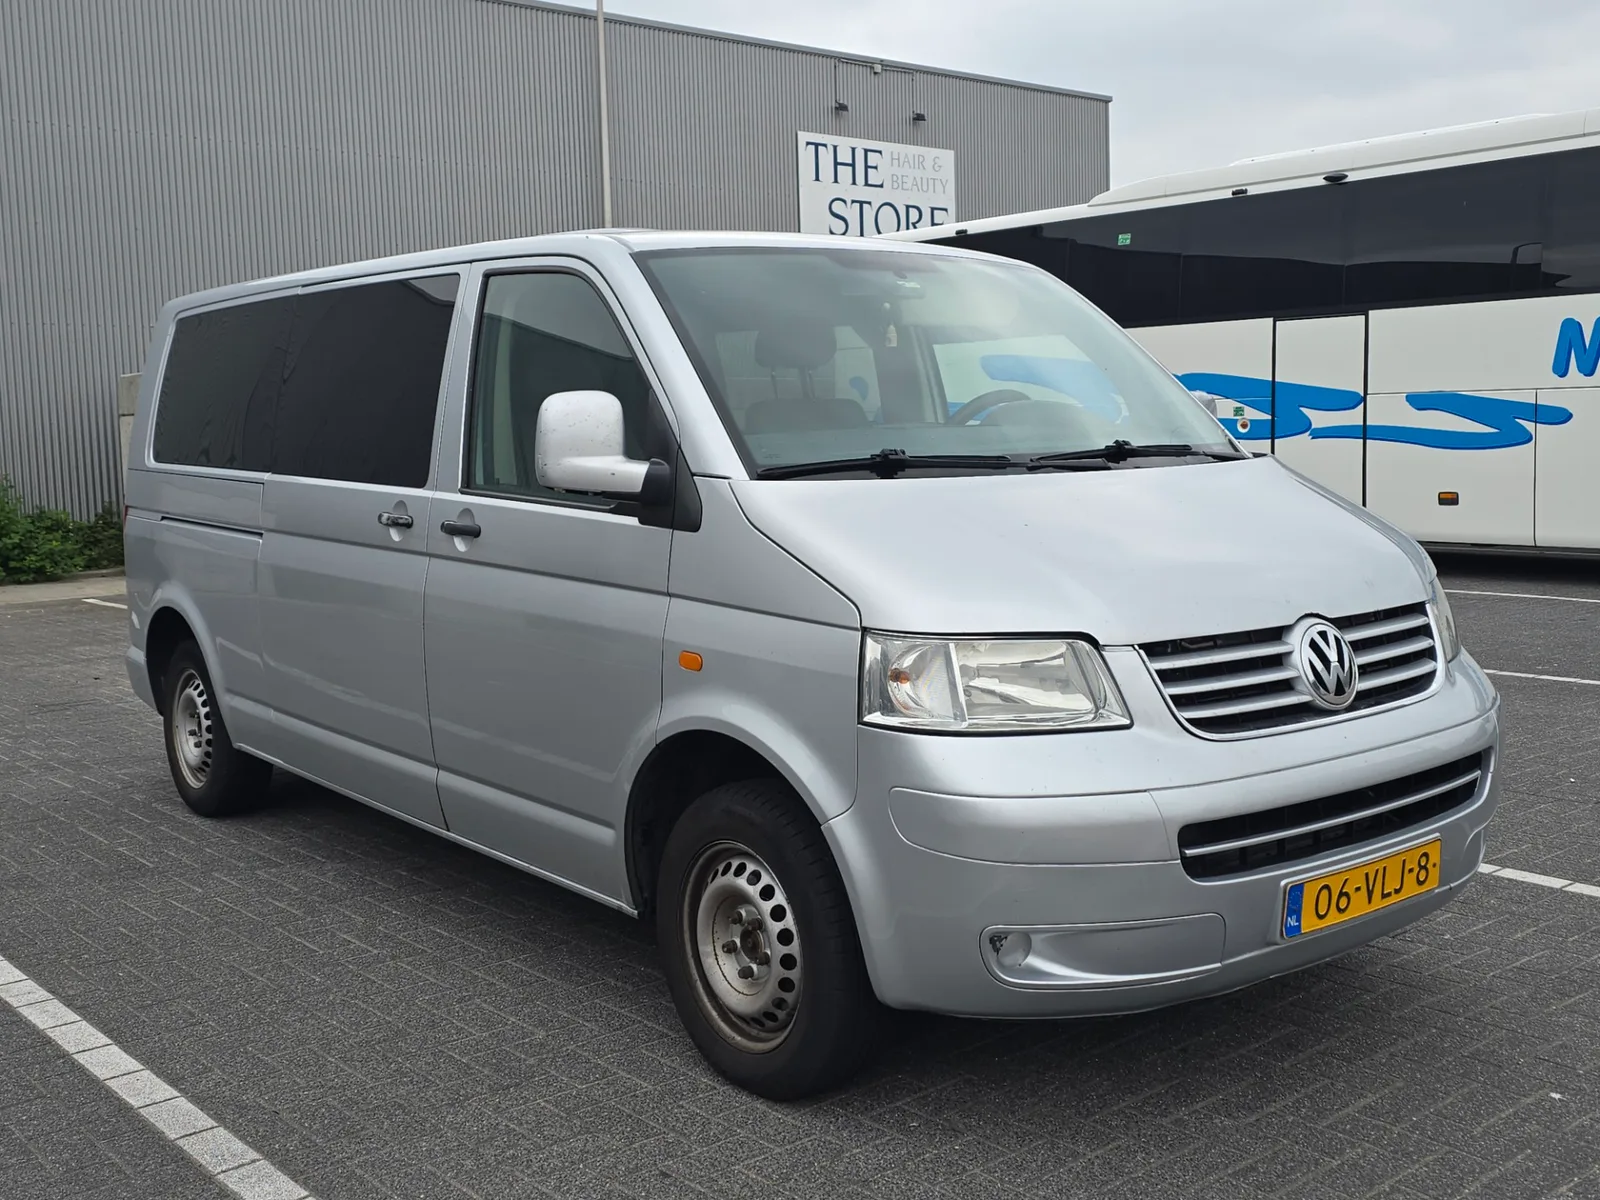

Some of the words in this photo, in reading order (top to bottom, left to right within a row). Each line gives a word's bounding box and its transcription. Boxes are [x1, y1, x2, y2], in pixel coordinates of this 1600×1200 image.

[805, 141, 885, 189] THE
[890, 150, 926, 171] HAIR
[932, 156, 943, 173] &
[891, 173, 949, 195] BEAUTY
[1314, 851, 1430, 921] 06-VLJ-8
[1287, 914, 1299, 928] NL
